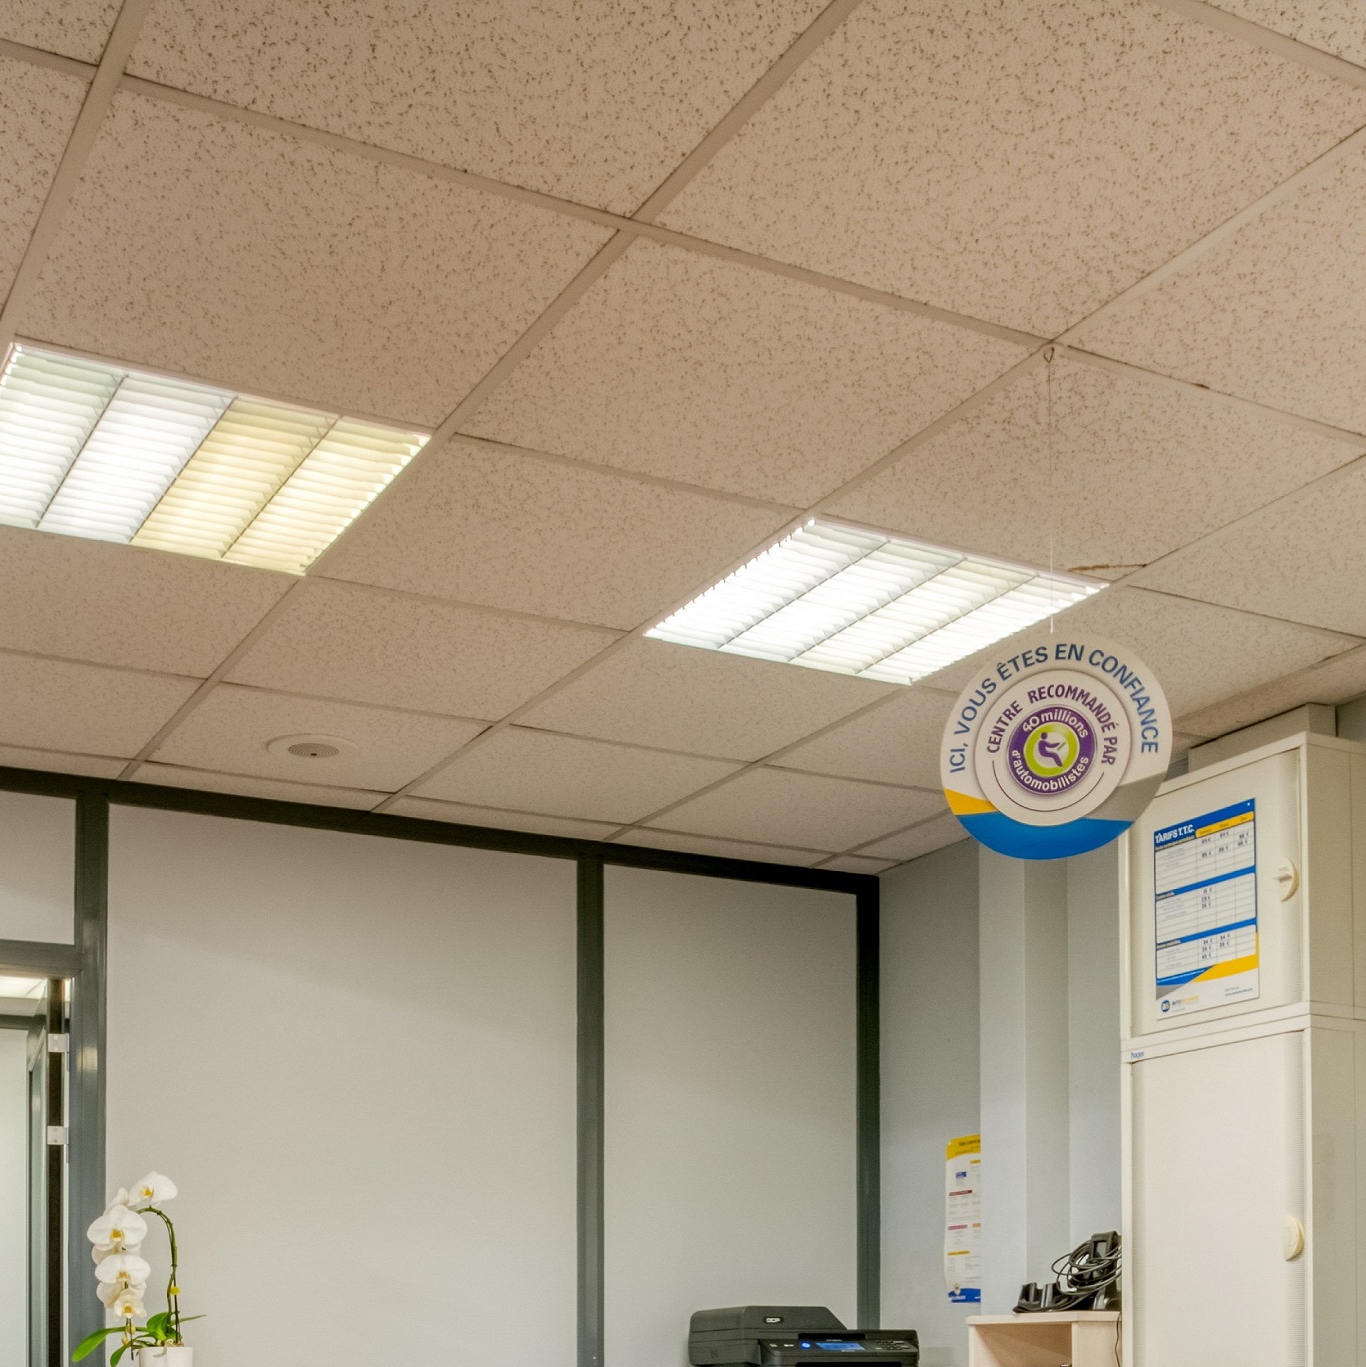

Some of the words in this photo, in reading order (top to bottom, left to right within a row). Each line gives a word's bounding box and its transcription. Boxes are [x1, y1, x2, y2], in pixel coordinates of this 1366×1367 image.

[996, 645, 1049, 682] ÊTES
[1054, 643, 1085, 662] EN
[955, 677, 998, 737] VOUS
[1088, 648, 1159, 755] CONFIANCE
[986, 700, 1024, 754] CENTRE
[1027, 684, 1118, 735] RECOMMANDÉ
[1100, 736, 1118, 767] PAR
[1021, 716, 1041, 733] 40
[1040, 708, 1089, 739] millions
[949, 744, 968, 774] ICI,
[1012, 749, 1090, 792] d'automobilistes
